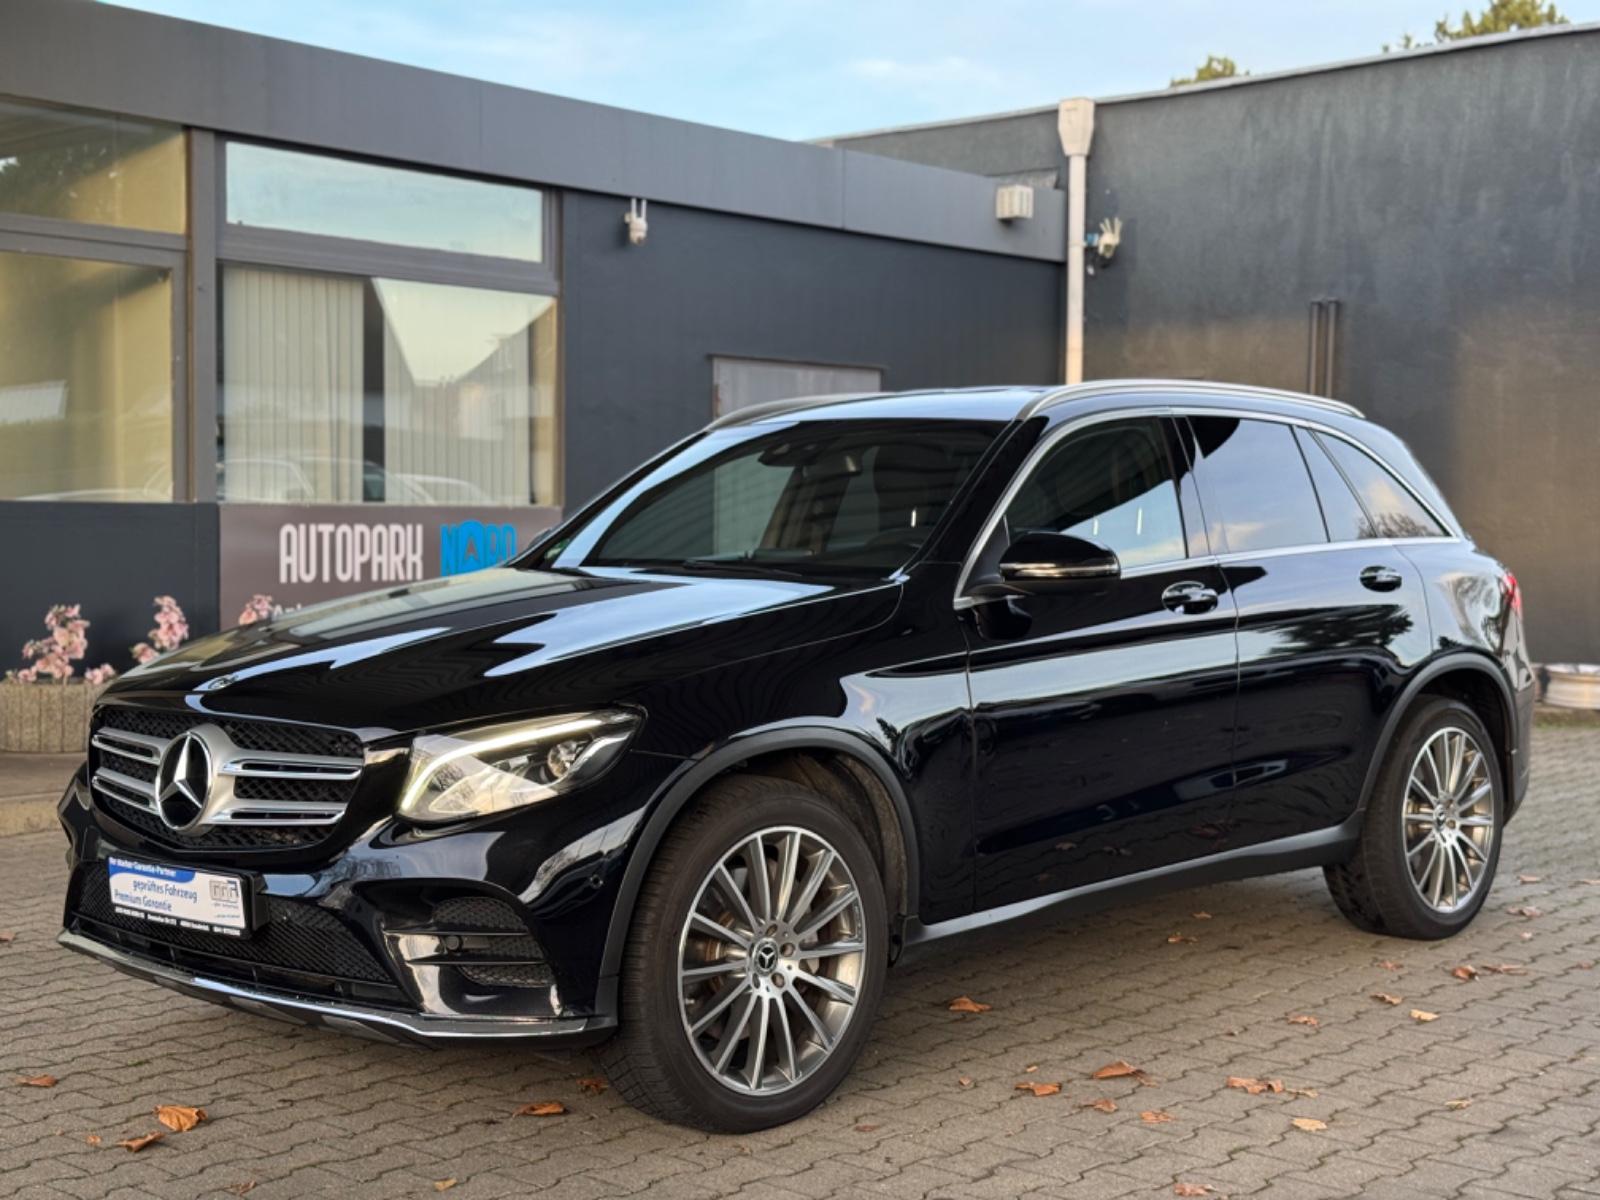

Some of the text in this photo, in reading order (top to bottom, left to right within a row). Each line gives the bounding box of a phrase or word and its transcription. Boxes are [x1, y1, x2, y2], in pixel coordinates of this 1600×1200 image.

[279, 523, 424, 584] AUTOPARK
[114, 889, 142, 904] Premium
[142, 895, 172, 912] Garantie
[133, 880, 164, 895] geprüftes
[165, 884, 198, 904] Fahrzeug
